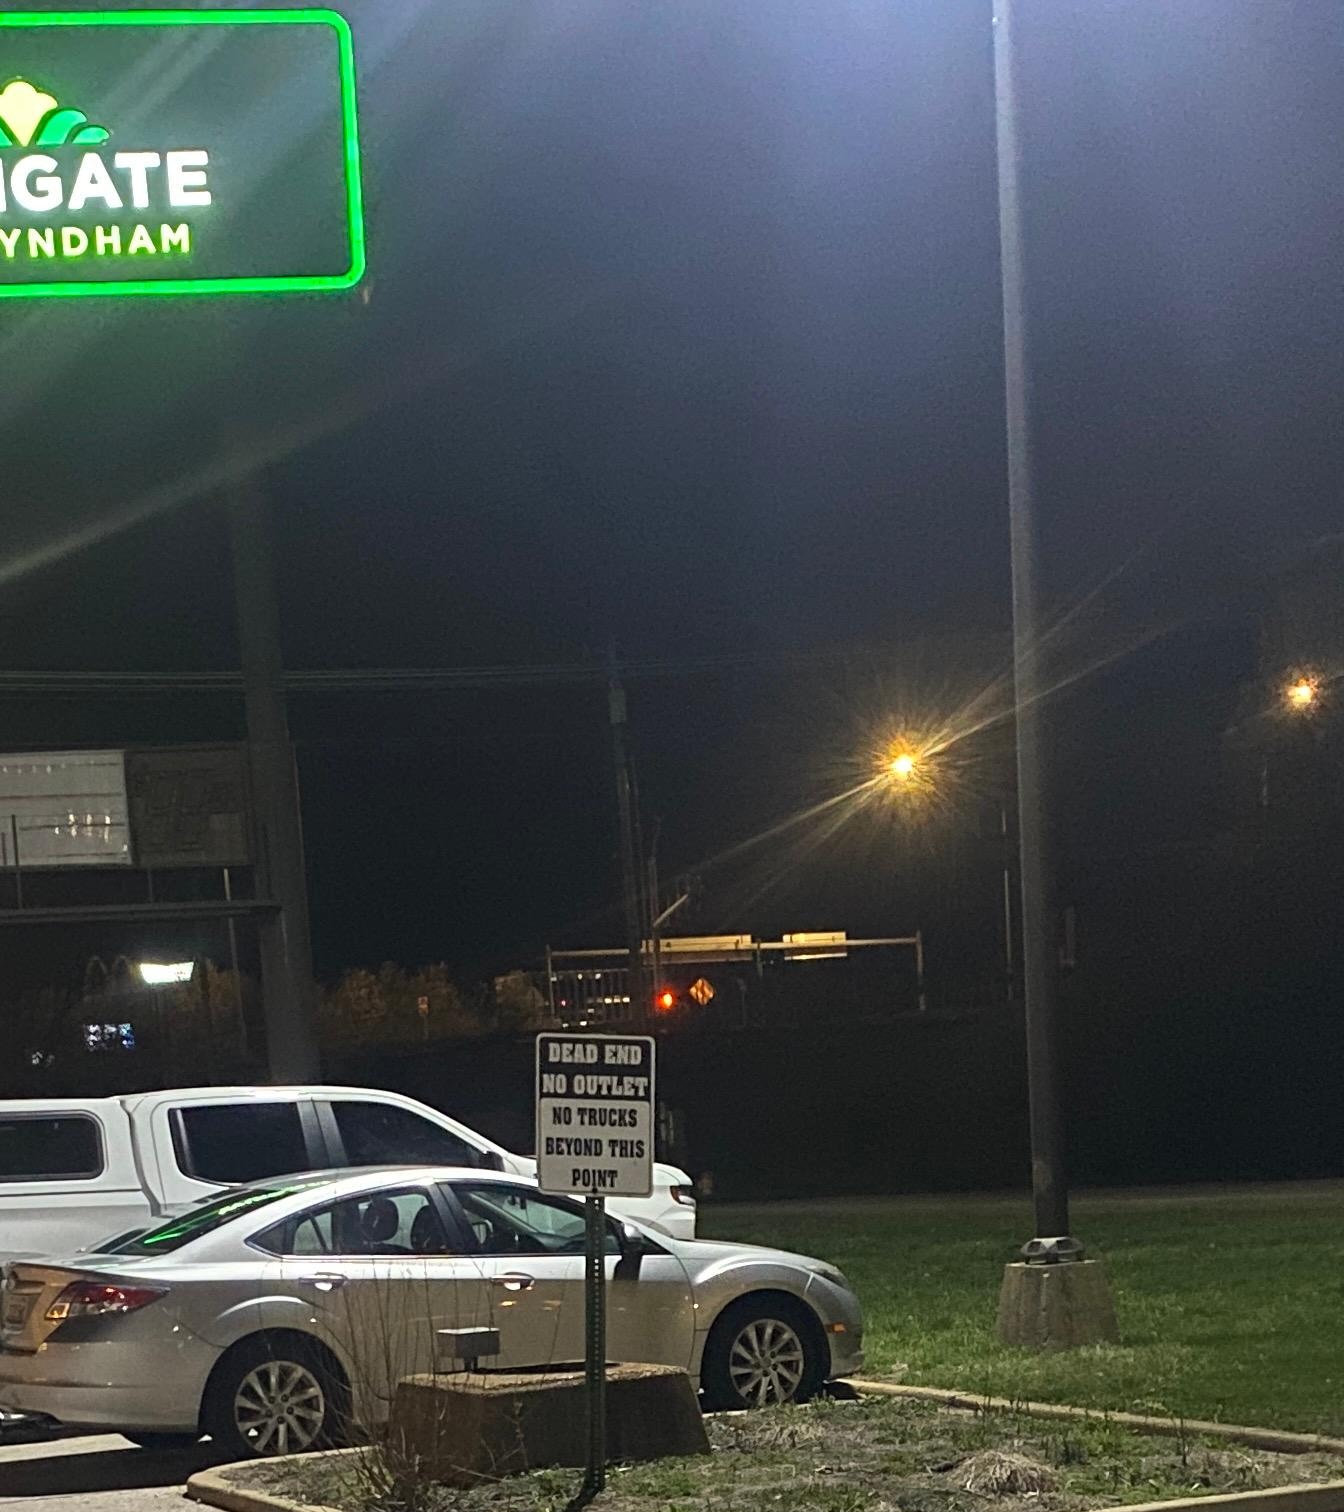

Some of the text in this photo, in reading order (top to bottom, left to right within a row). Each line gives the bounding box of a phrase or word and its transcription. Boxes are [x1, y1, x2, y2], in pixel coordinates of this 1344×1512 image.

[548, 1042, 641, 1065] DEAD END
[542, 1073, 648, 1096] NO OUTLET
[552, 1106, 638, 1128] NO TRUCKS
[545, 1136, 645, 1159] BEYOND THIS
[571, 1168, 618, 1188] POINT
